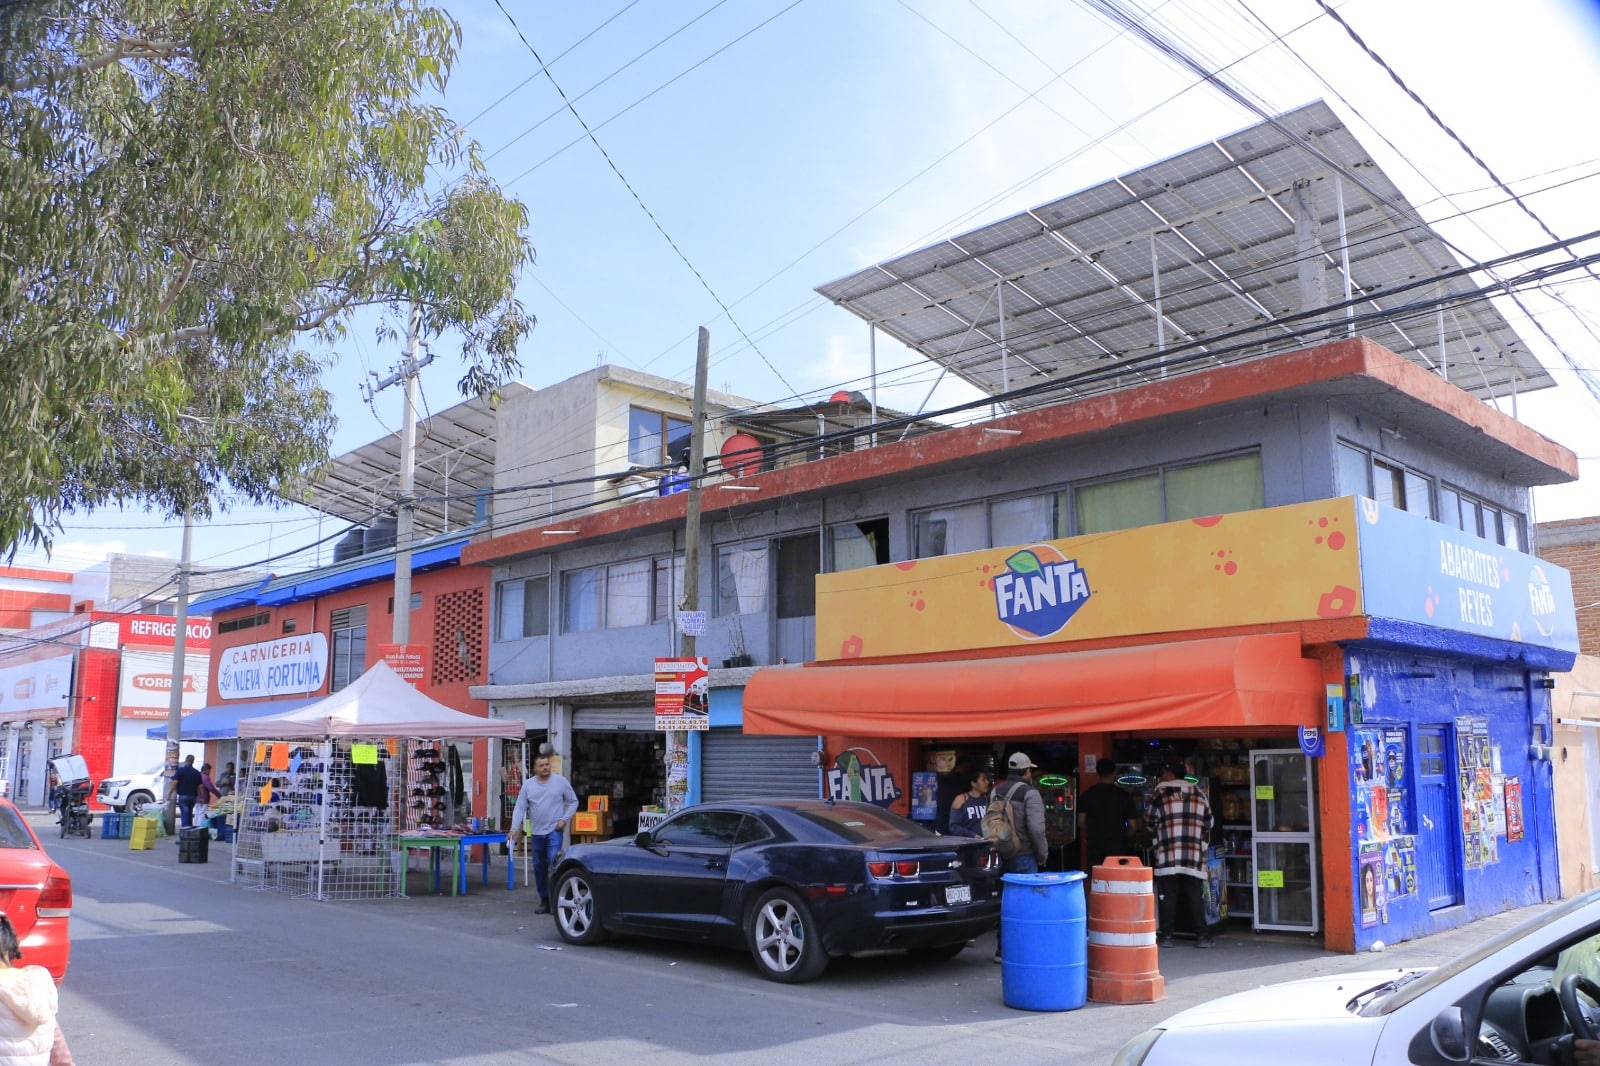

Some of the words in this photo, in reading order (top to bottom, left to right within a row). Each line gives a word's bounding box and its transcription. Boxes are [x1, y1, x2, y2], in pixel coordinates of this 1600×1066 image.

[1440, 539, 1500, 589] ABARROTES
[995, 562, 1089, 619] FANTA
[1528, 582, 1556, 616] FANTA
[1458, 587, 1493, 627] REYES
[131, 620, 211, 639] REFRIGEACIÓ
[232, 640, 311, 665] CARNICERIA
[137, 677, 189, 688] TORRY
[233, 669, 260, 692] NUEVA
[267, 661, 320, 689] FORTUNA
